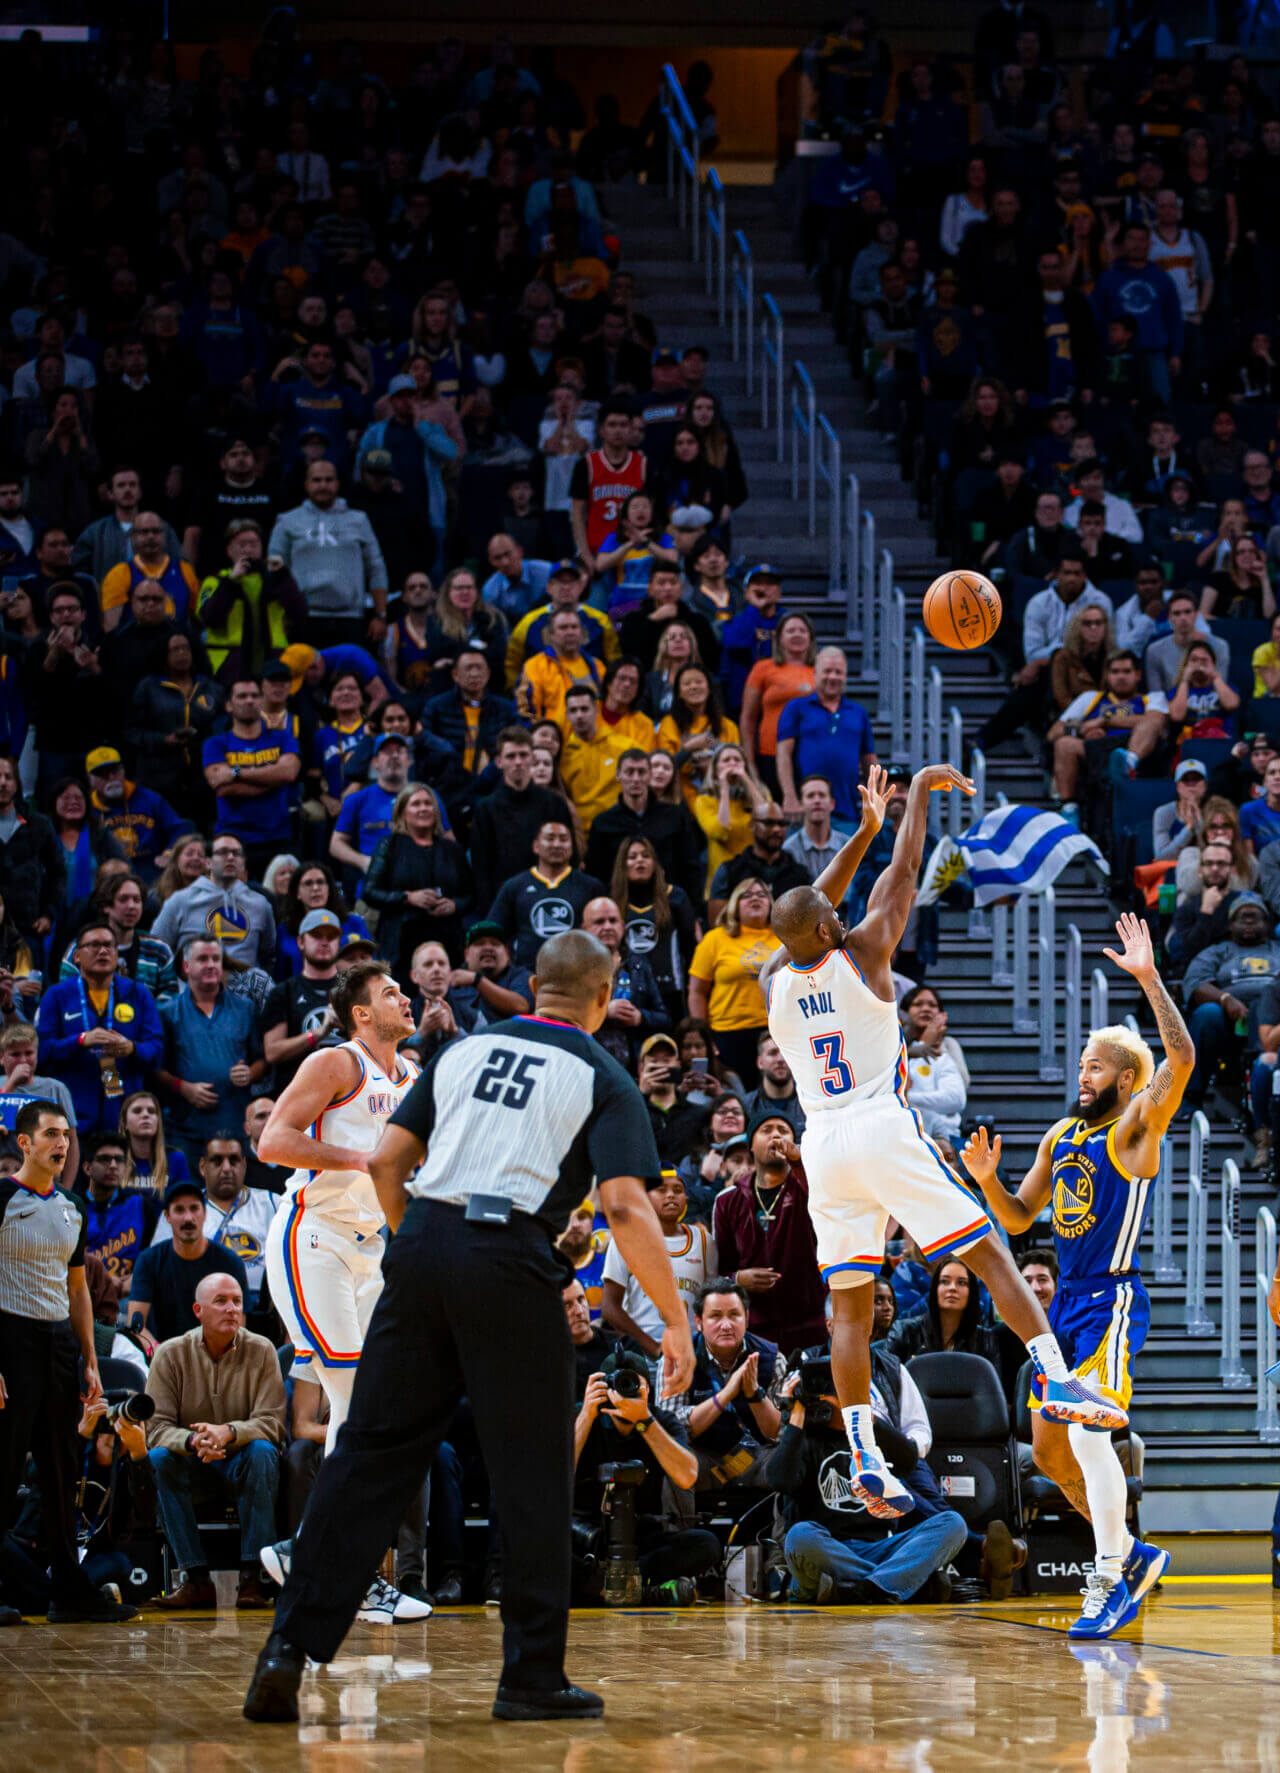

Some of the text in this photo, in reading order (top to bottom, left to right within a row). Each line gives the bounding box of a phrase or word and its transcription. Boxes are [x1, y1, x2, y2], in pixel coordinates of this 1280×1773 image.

[551, 906, 568, 919] 30
[797, 991, 836, 1019] PAUL
[810, 1030, 856, 1098] 3
[472, 1047, 548, 1110] 25
[1076, 1178, 1089, 1197] 12
[946, 1454, 964, 1463] 120
[1036, 1561, 1097, 1577] CHAS
